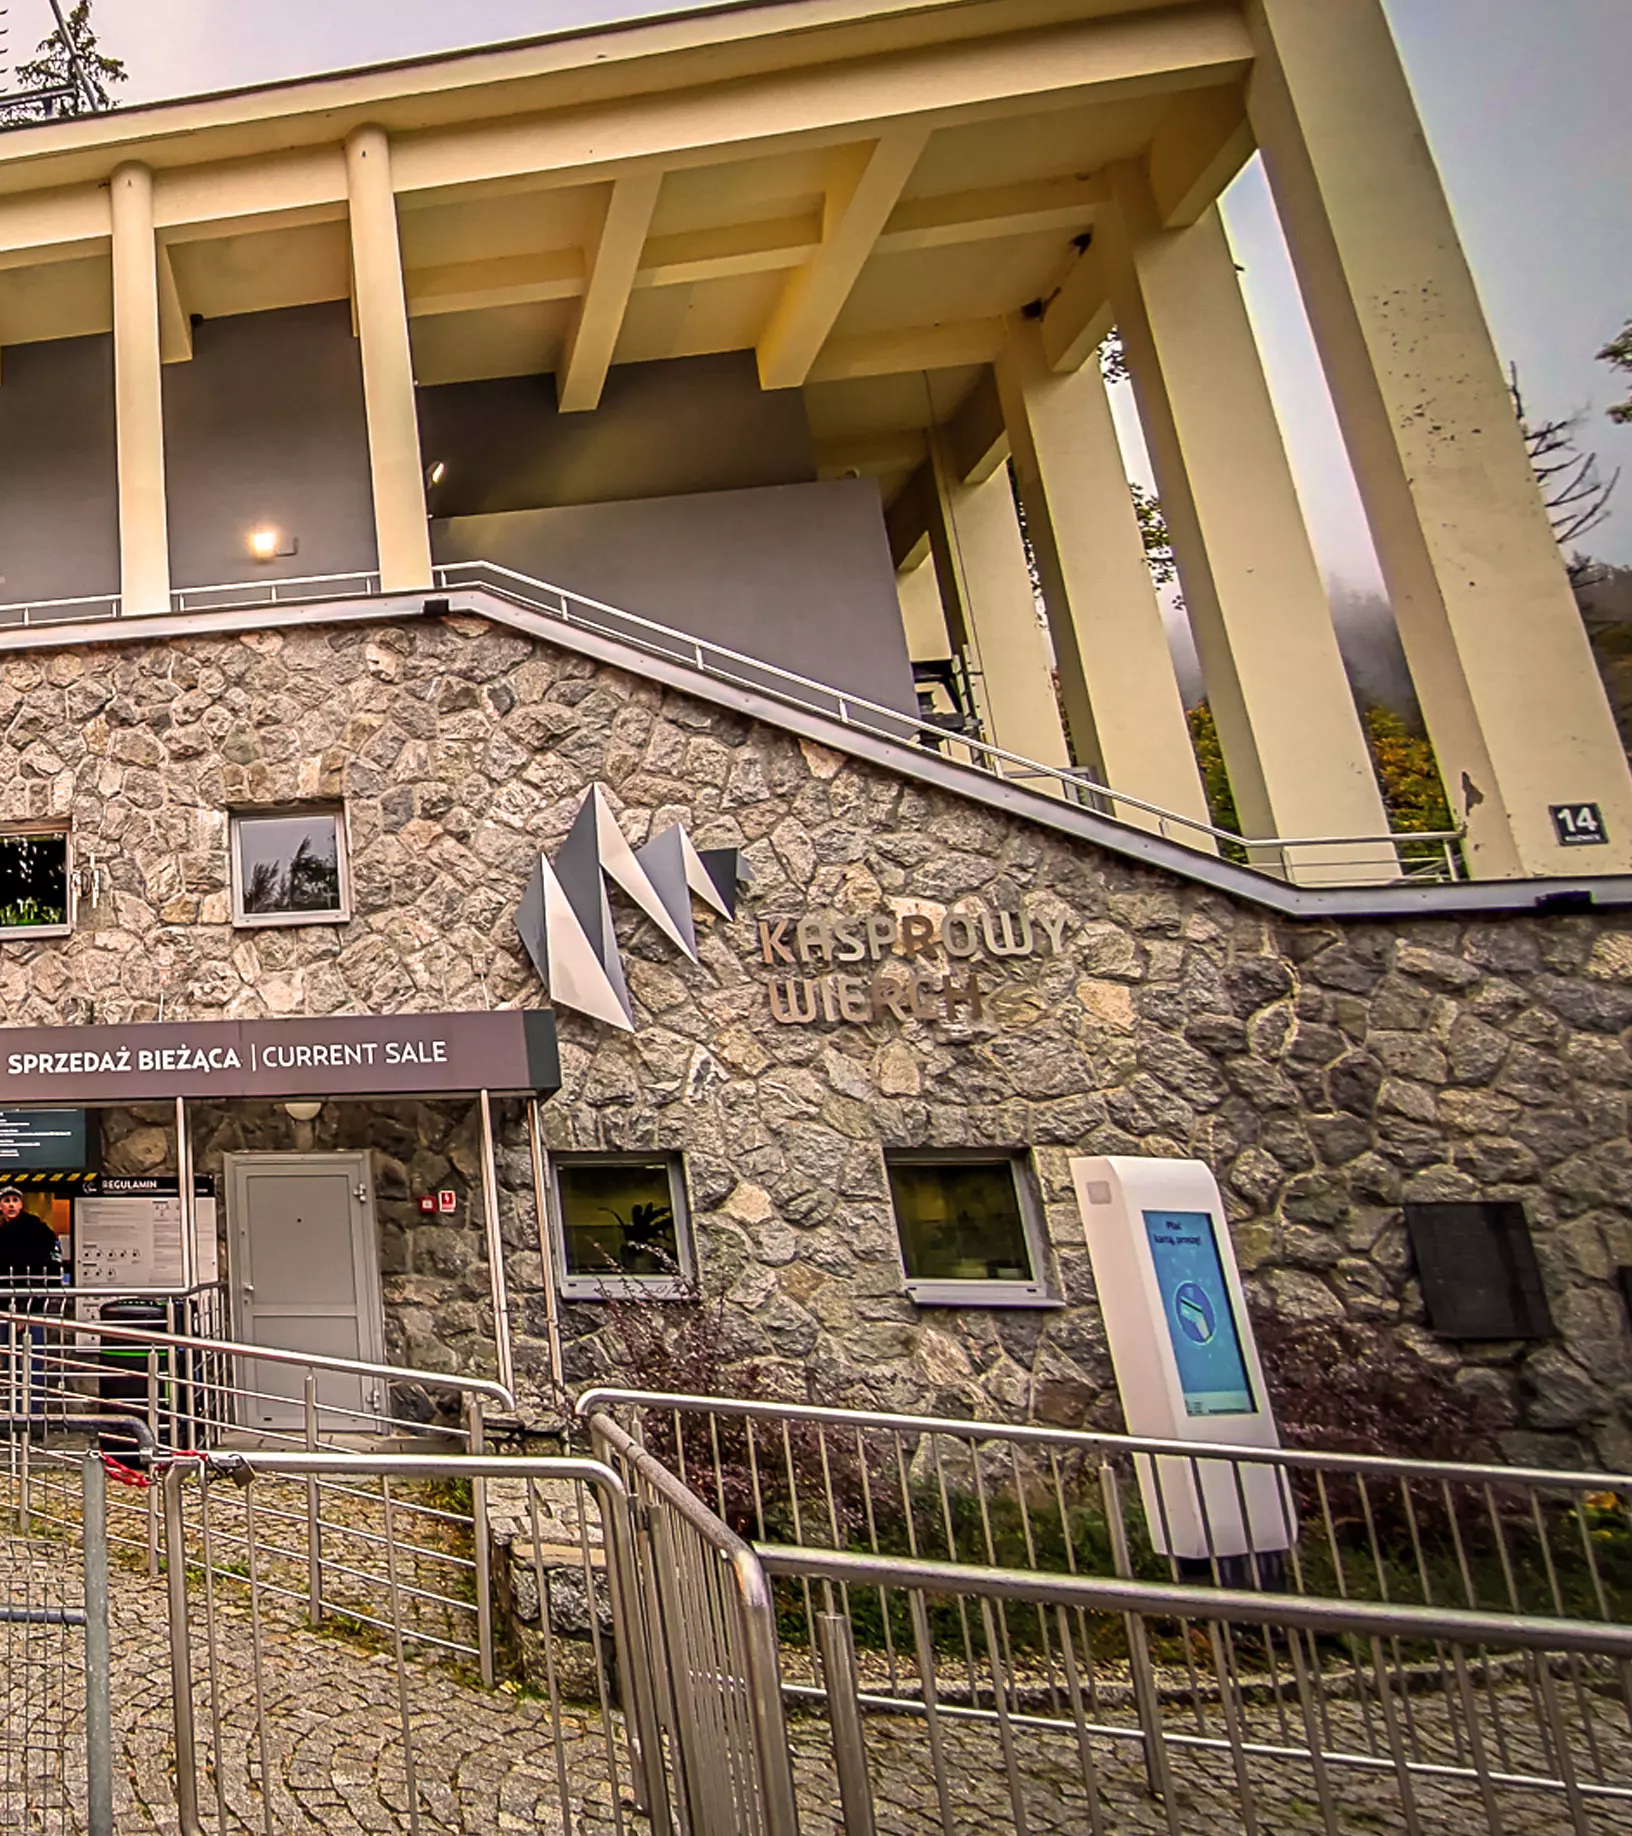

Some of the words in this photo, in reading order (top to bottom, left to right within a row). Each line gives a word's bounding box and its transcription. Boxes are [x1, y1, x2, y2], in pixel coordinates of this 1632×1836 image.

[1557, 806, 1598, 832] 14
[757, 910, 1068, 964] KASPROWY
[769, 973, 984, 1024] WIERCH
[7, 1045, 132, 1075] SPRZEDAŻ
[138, 1043, 242, 1073] BIEŻĄCA
[262, 1042, 378, 1069] CURRENT
[384, 1040, 448, 1066] SALE
[101, 1179, 158, 1190] REGULAMIN
